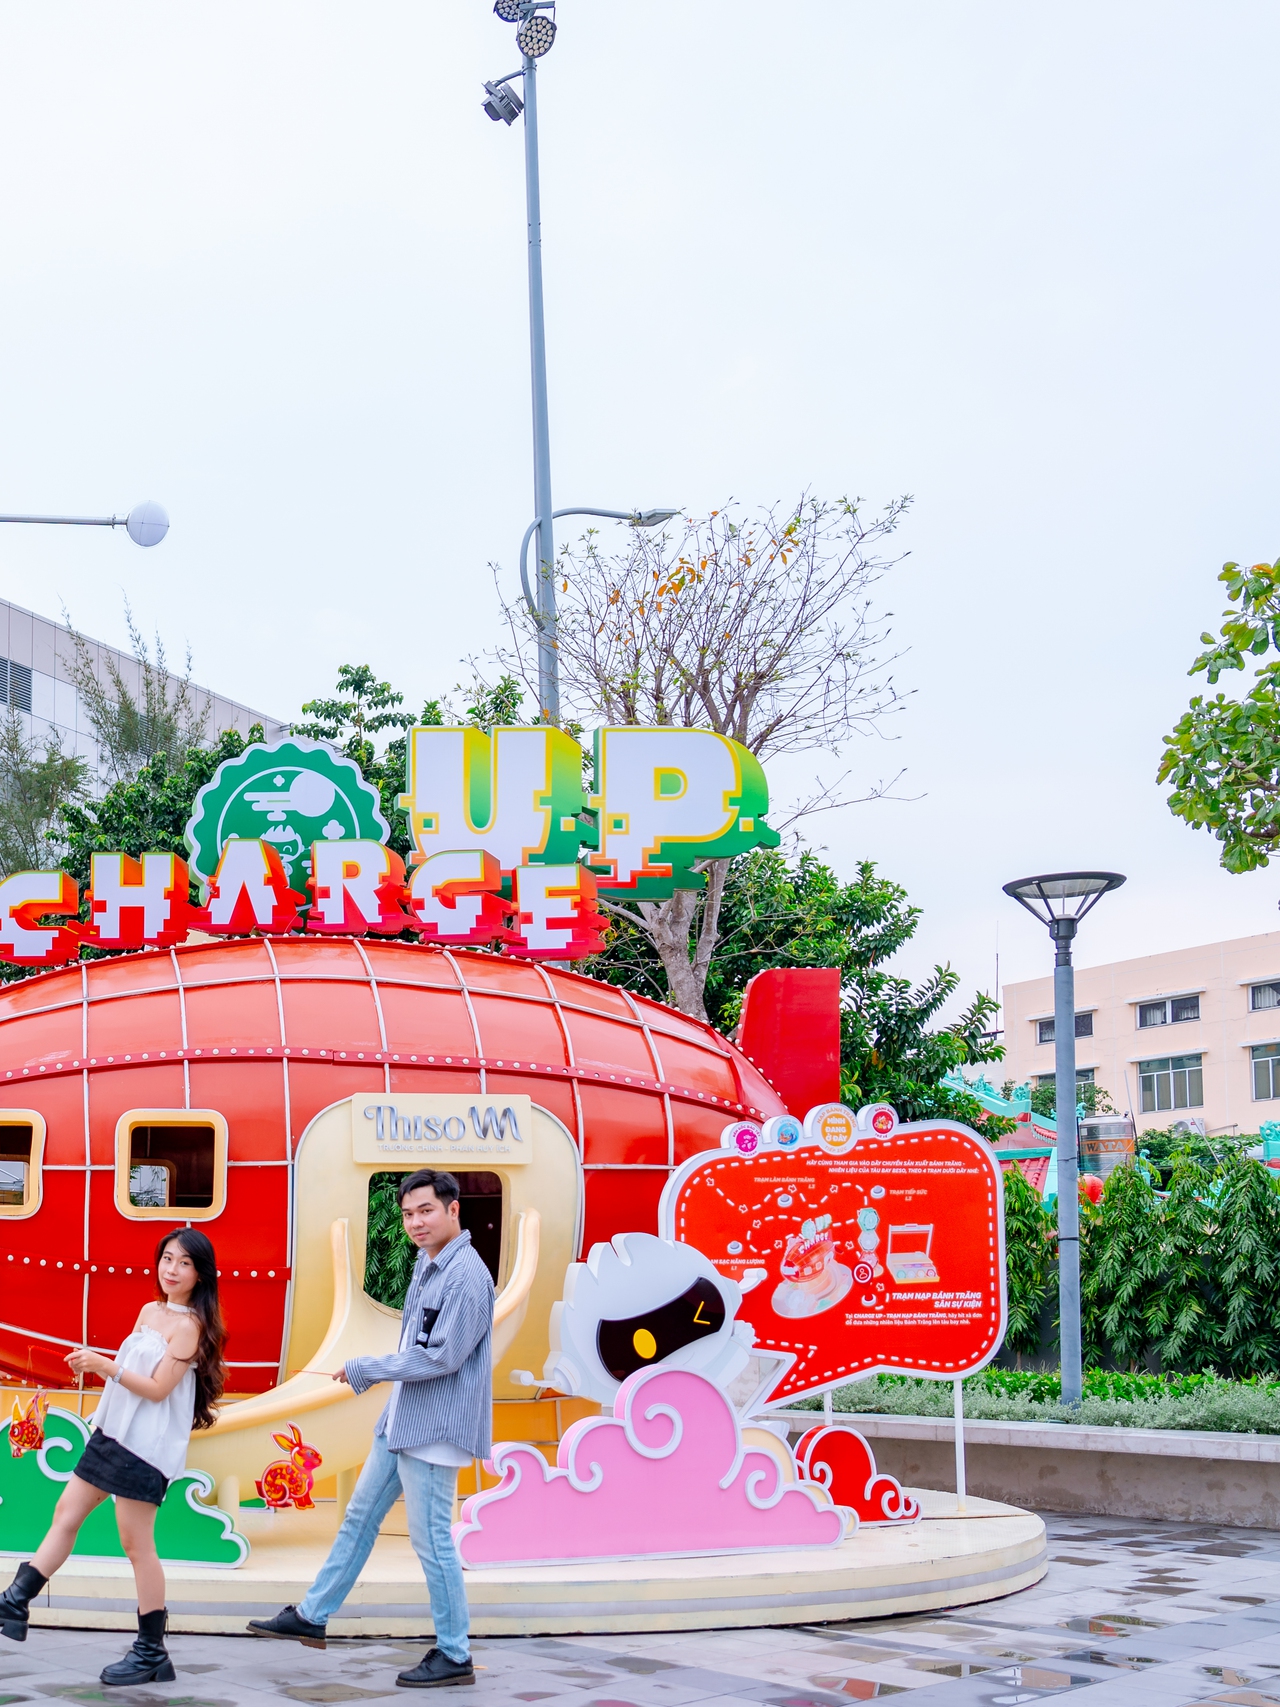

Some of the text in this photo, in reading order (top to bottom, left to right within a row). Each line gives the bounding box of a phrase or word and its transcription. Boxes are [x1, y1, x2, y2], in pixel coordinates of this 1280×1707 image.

[394, 725, 781, 903] UP
[364, 1105, 466, 1141] Thiso
[892, 1292, 914, 1301] TRẠM
[915, 1292, 931, 1301] NẠP
[932, 1291, 954, 1299] BÁNH
[964, 1300, 982, 1309] KIỆN
